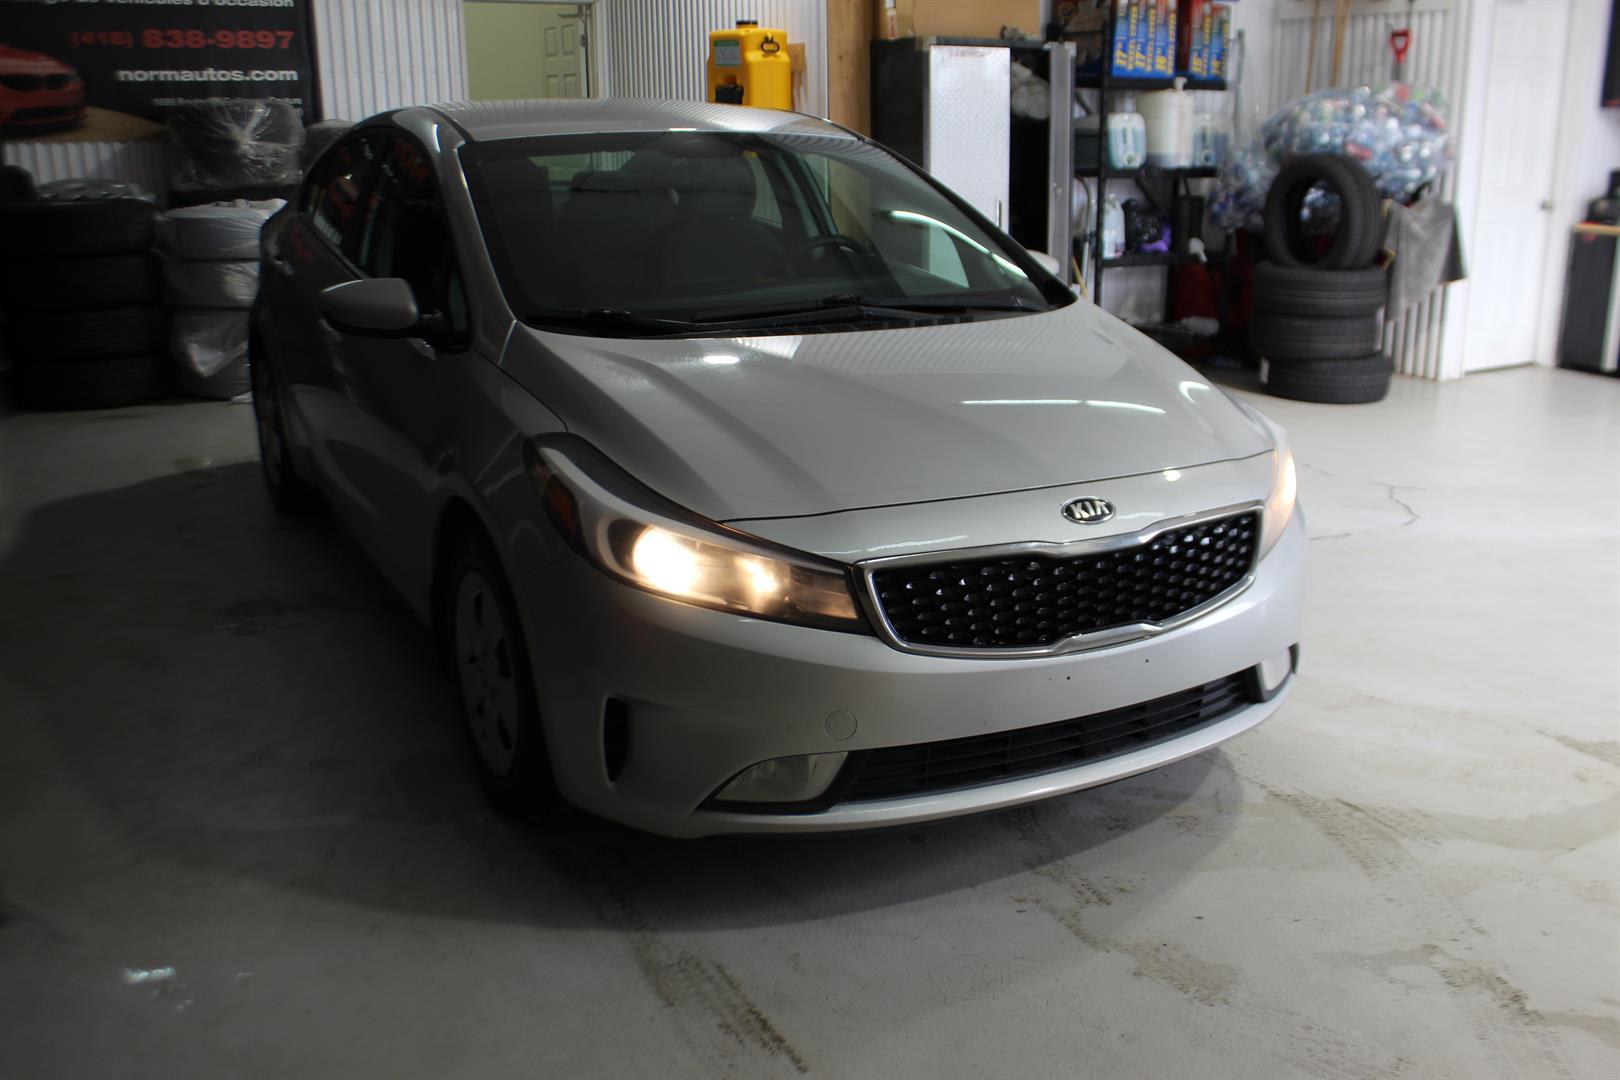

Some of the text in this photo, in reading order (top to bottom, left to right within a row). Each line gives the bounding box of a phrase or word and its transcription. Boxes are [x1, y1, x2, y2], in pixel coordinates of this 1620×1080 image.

[71, 29, 295, 49] (418) 838-9897
[118, 67, 299, 82] normautos.com
[1069, 500, 1110, 519] KIA
